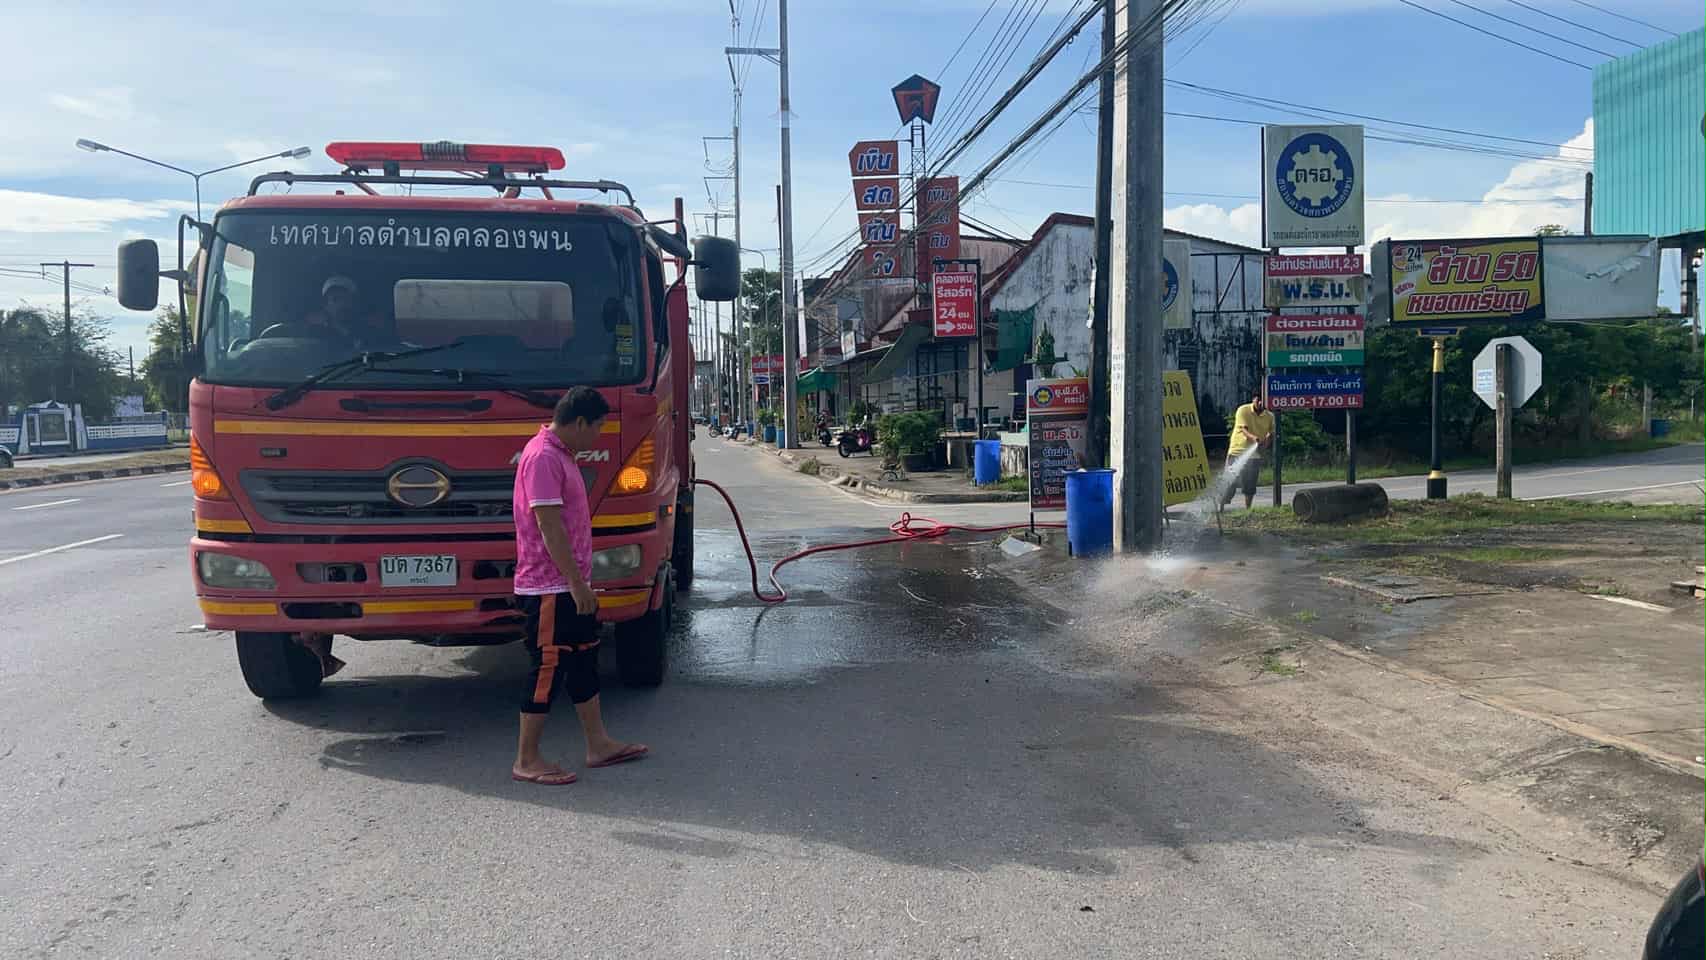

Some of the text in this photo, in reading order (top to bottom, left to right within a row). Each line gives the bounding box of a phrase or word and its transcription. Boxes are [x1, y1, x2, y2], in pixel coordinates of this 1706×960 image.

[856, 147, 893, 172] เงิน
[1295, 168, 1336, 183] ตรอ.
[863, 184, 894, 204] สด
[269, 218, 573, 251] เทศบาลตำบลคลองพน
[864, 217, 896, 242] ทัน
[1407, 247, 1421, 262] 24
[1427, 245, 1490, 284] ล้าง
[1493, 252, 1538, 281] รถ
[1283, 281, 1352, 299] พ.ร.บ.
[1407, 286, 1528, 315] หยอดเหรียญ
[939, 307, 957, 319] 24
[1275, 317, 1358, 329] ต่อทะเบียน
[1289, 351, 1343, 366] รถทุกชนิด
[1270, 380, 1313, 392] เปิดบริการ
[1272, 396, 1344, 408] 08.00-17.00
[575, 449, 610, 462] FM
[413, 556, 454, 574] 7367
